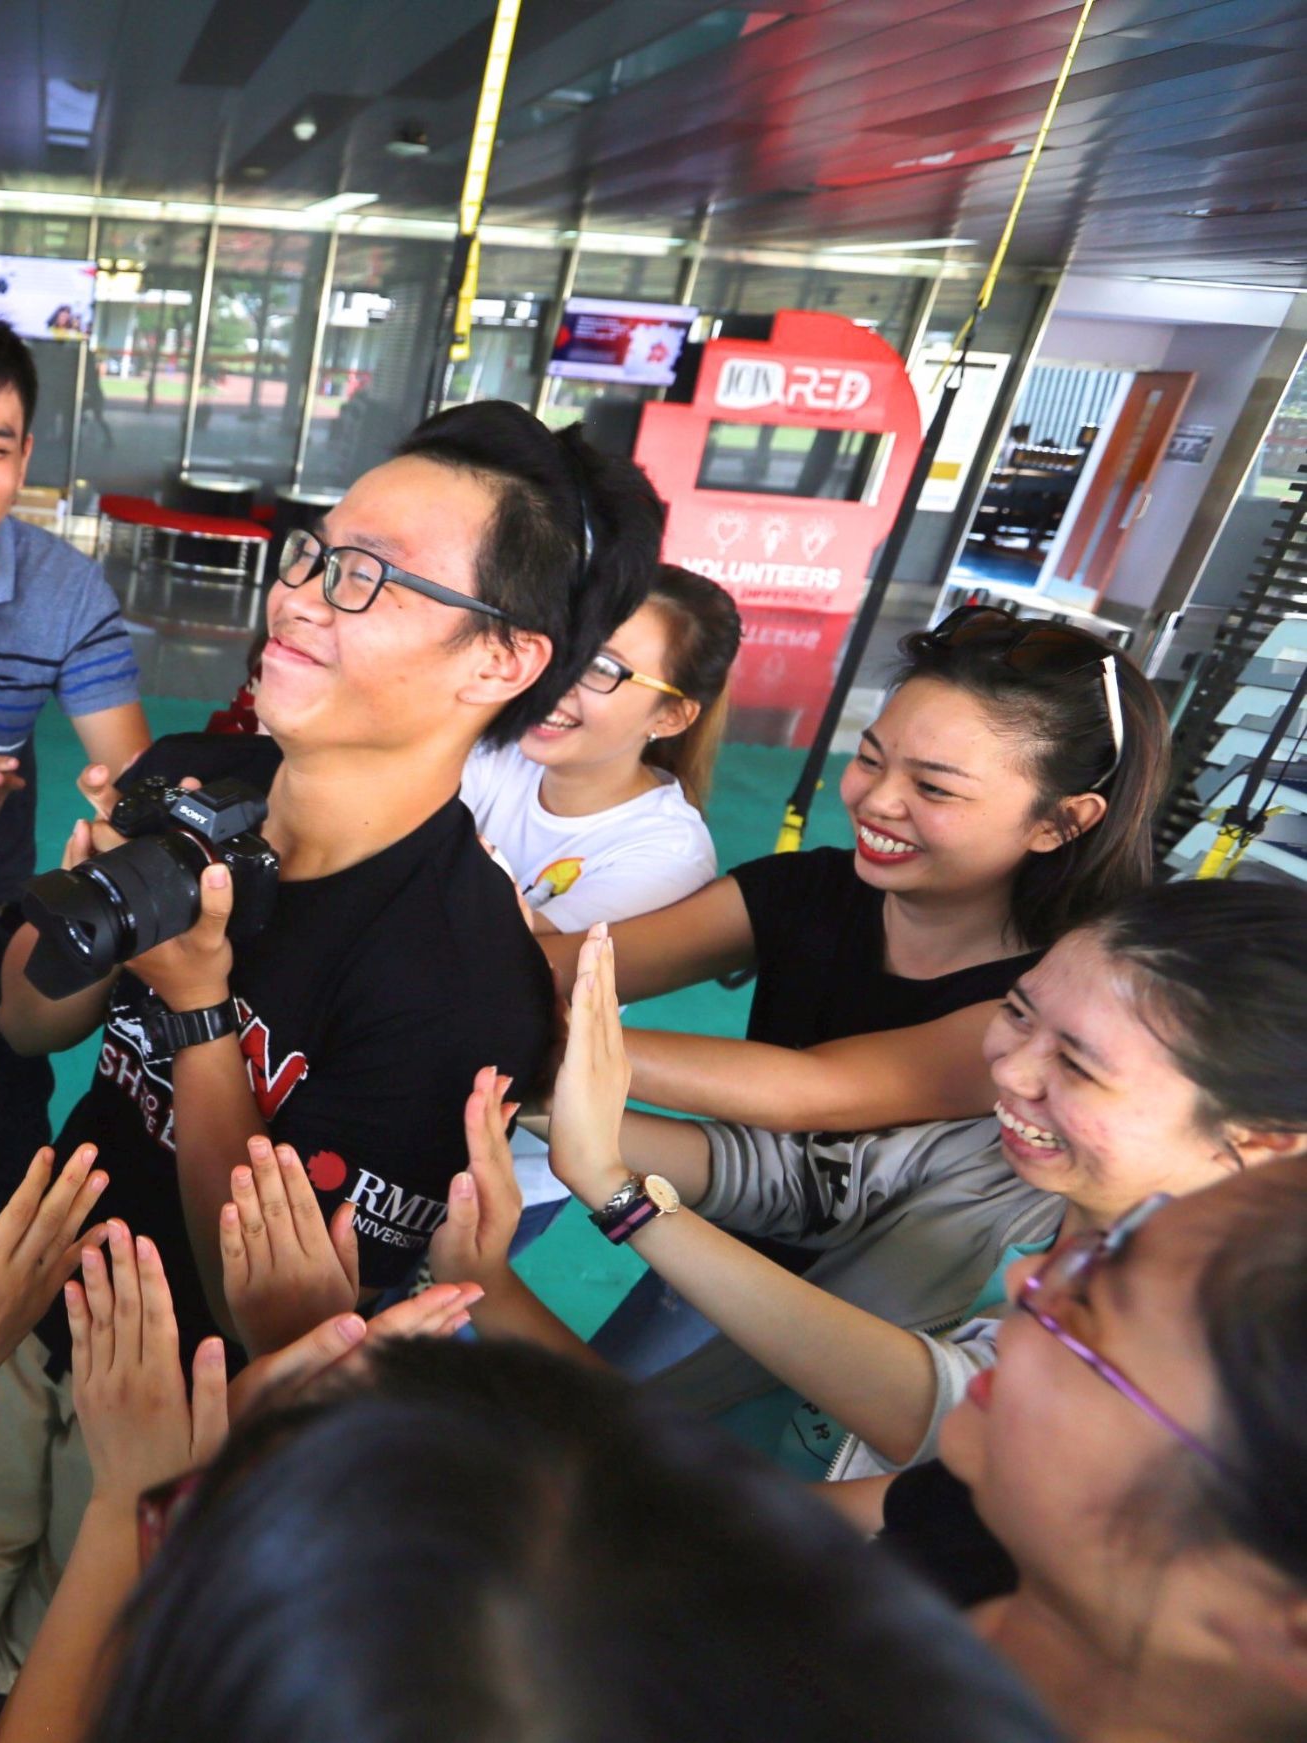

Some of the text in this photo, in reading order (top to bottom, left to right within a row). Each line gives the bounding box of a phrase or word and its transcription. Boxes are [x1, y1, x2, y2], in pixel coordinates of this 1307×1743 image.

[784, 366, 871, 410] RED
[179, 804, 209, 825] SONY
[344, 1167, 448, 1234] RMIT
